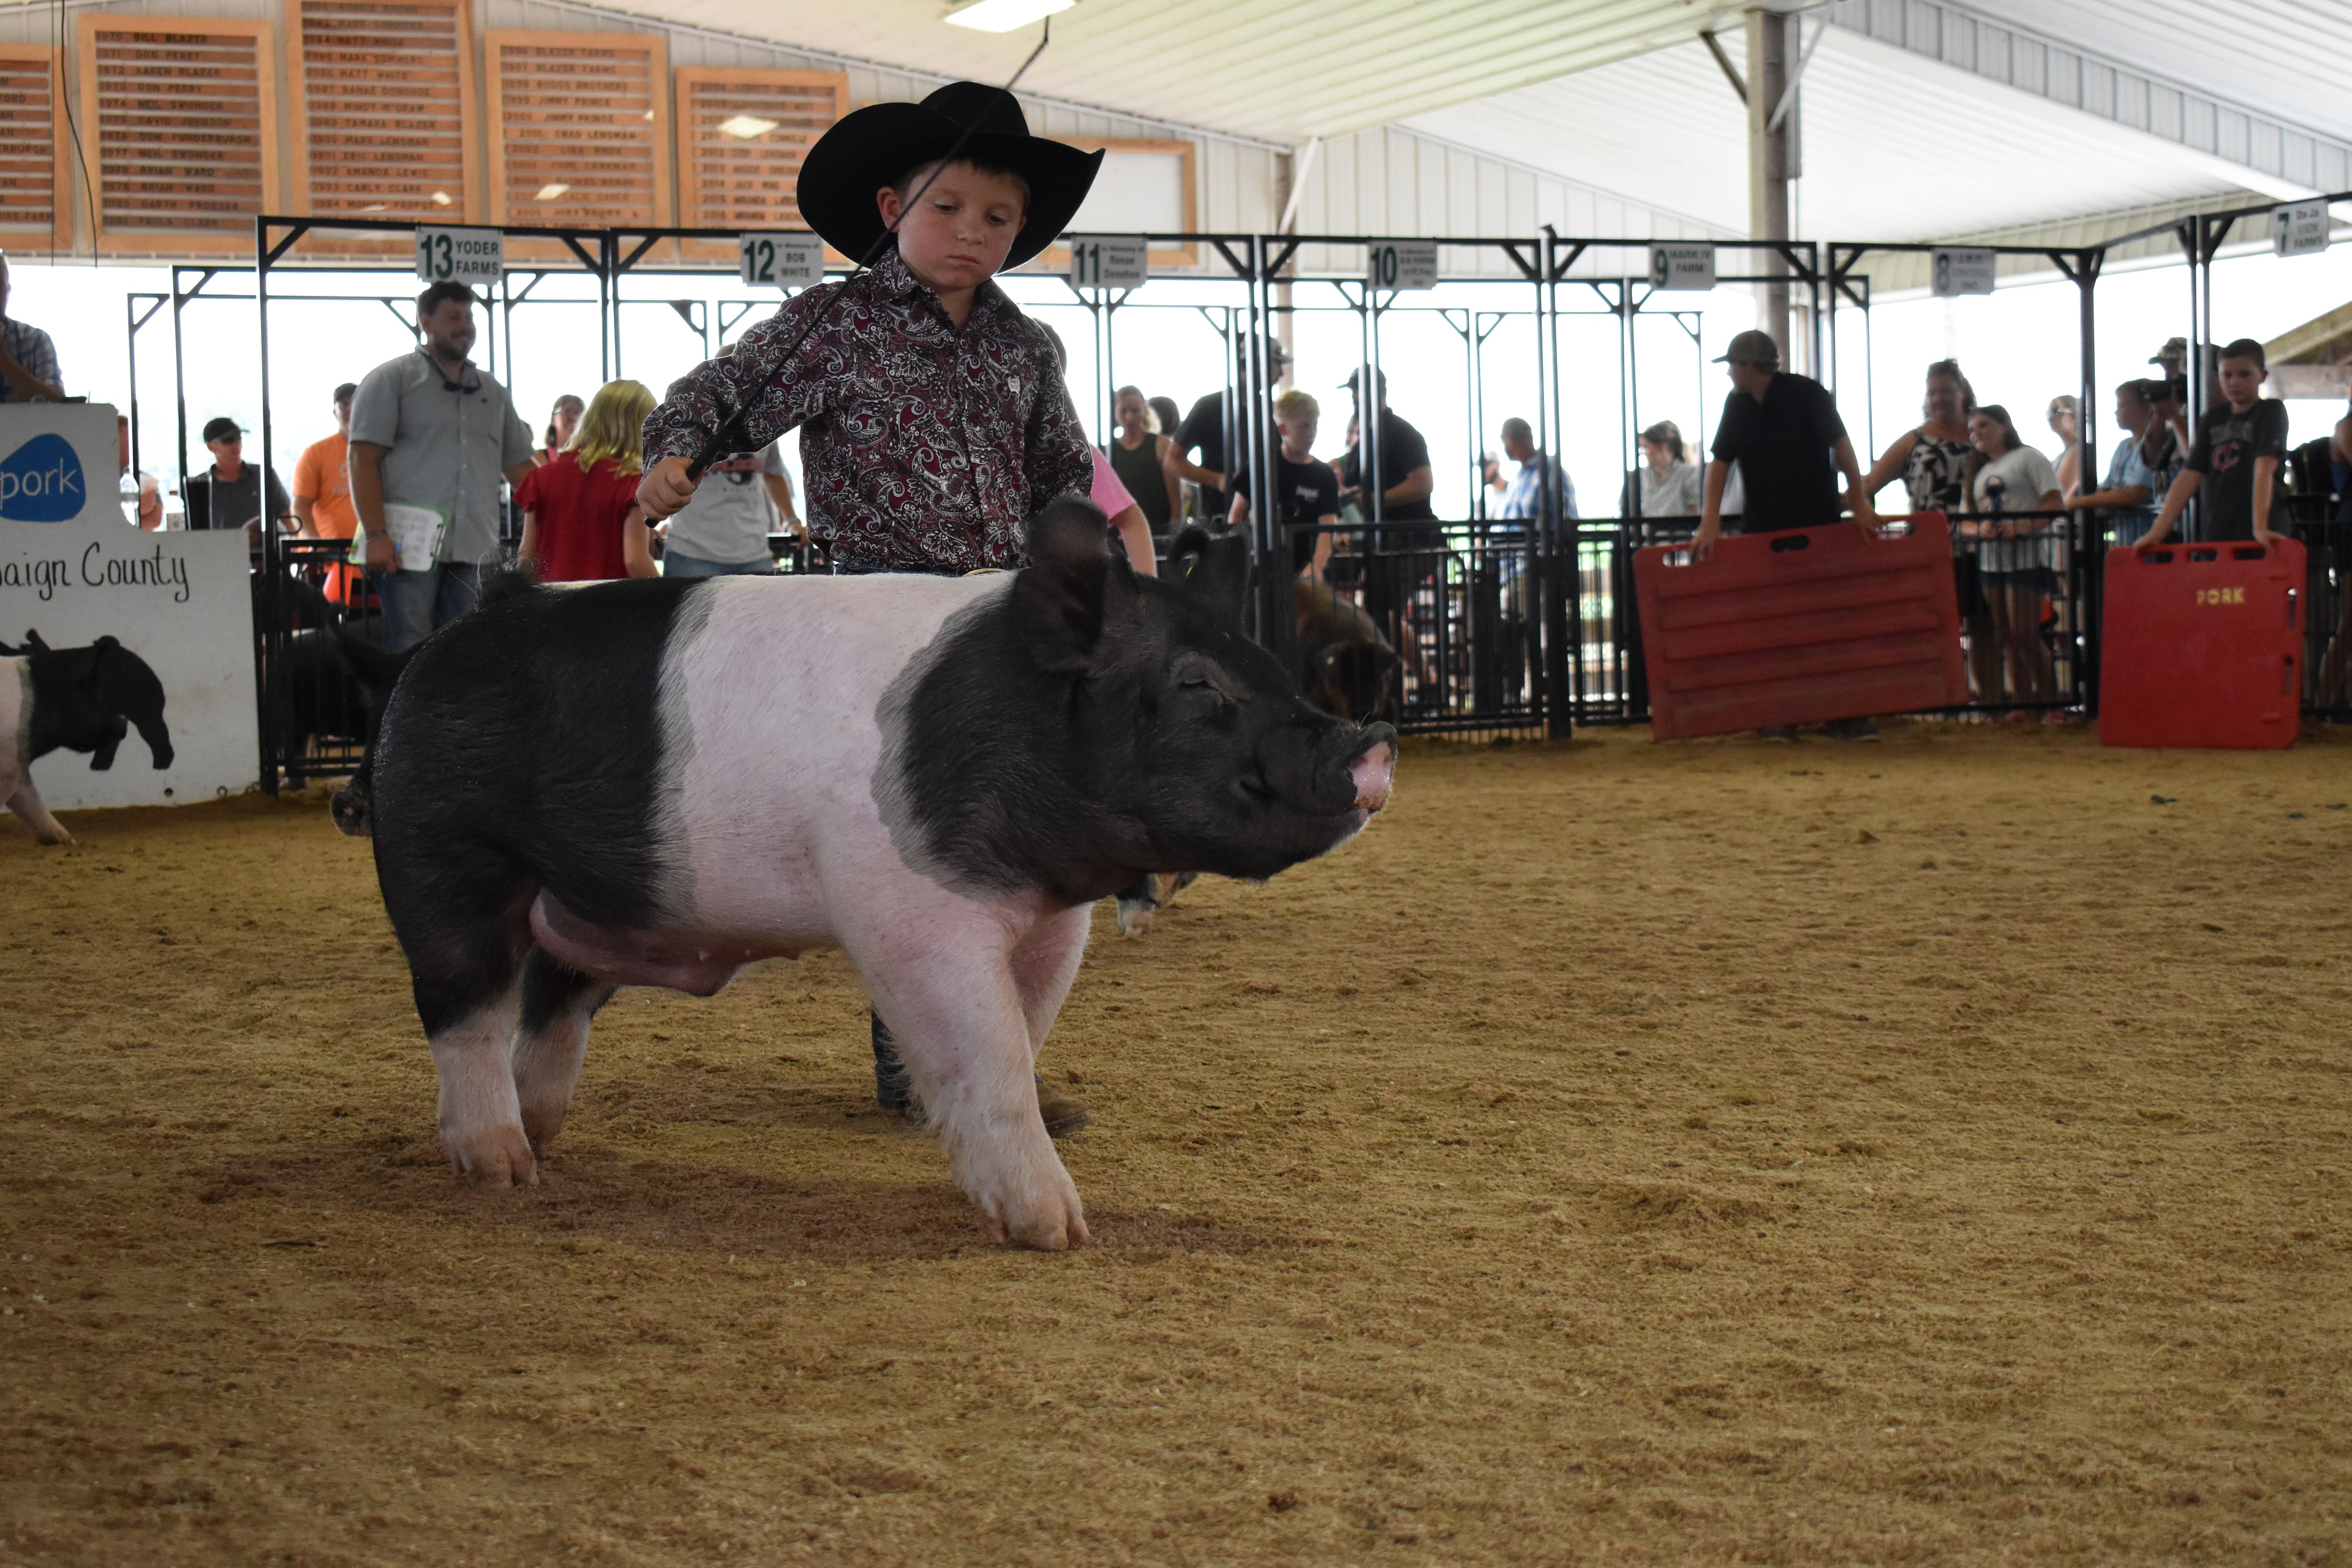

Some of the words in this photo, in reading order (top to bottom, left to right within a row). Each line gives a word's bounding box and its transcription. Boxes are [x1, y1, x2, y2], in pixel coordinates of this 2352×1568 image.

[134, 34, 157, 42] BILL
[165, 34, 208, 43] BLAZER
[337, 36, 366, 45] MATT
[136, 50, 158, 59] DON
[165, 50, 201, 60] PERRY
[339, 52, 368, 61] MARK
[137, 67, 172, 75] KAREN
[179, 68, 221, 77] BLAZER
[340, 69, 368, 78] MATT
[377, 70, 407, 80] WHITE
[138, 83, 160, 91] DON
[168, 84, 202, 93] PERRY
[138, 116, 171, 125] DAVID
[183, 118, 232, 127] JOHNSON
[140, 133, 162, 141] DON
[555, 129, 582, 138] CHAD
[139, 149, 162, 159] NEIL
[172, 150, 224, 160] SWONGER
[140, 166, 172, 175] BRIAN
[186, 167, 214, 177] WARD
[347, 167, 389, 176] AMANDA
[141, 183, 173, 192] BRIAN
[186, 184, 214, 193] WARD
[347, 183, 381, 192] CARLY
[141, 200, 177, 209] GARTH
[138, 217, 173, 227] PAULA
[2277, 212, 2290, 253] 7
[456, 240, 499, 255] YODER
[2294, 235, 2323, 249] FARMS
[420, 234, 453, 279] 13
[786, 252, 805, 263] BOB
[1668, 250, 1698, 259] MARK
[1702, 250, 1711, 259] IV
[744, 239, 775, 282] 12
[1074, 243, 1099, 284] 11
[456, 261, 499, 275] FARMS
[1371, 246, 1396, 287] 10
[1654, 249, 1668, 288] 9
[781, 268, 810, 277] WHITE
[1937, 253, 1950, 292] 8
[0, 458, 79, 510] pork
[0, 551, 72, 601] aign
[82, 541, 190, 603] County
[2196, 586, 2245, 606] PORK
